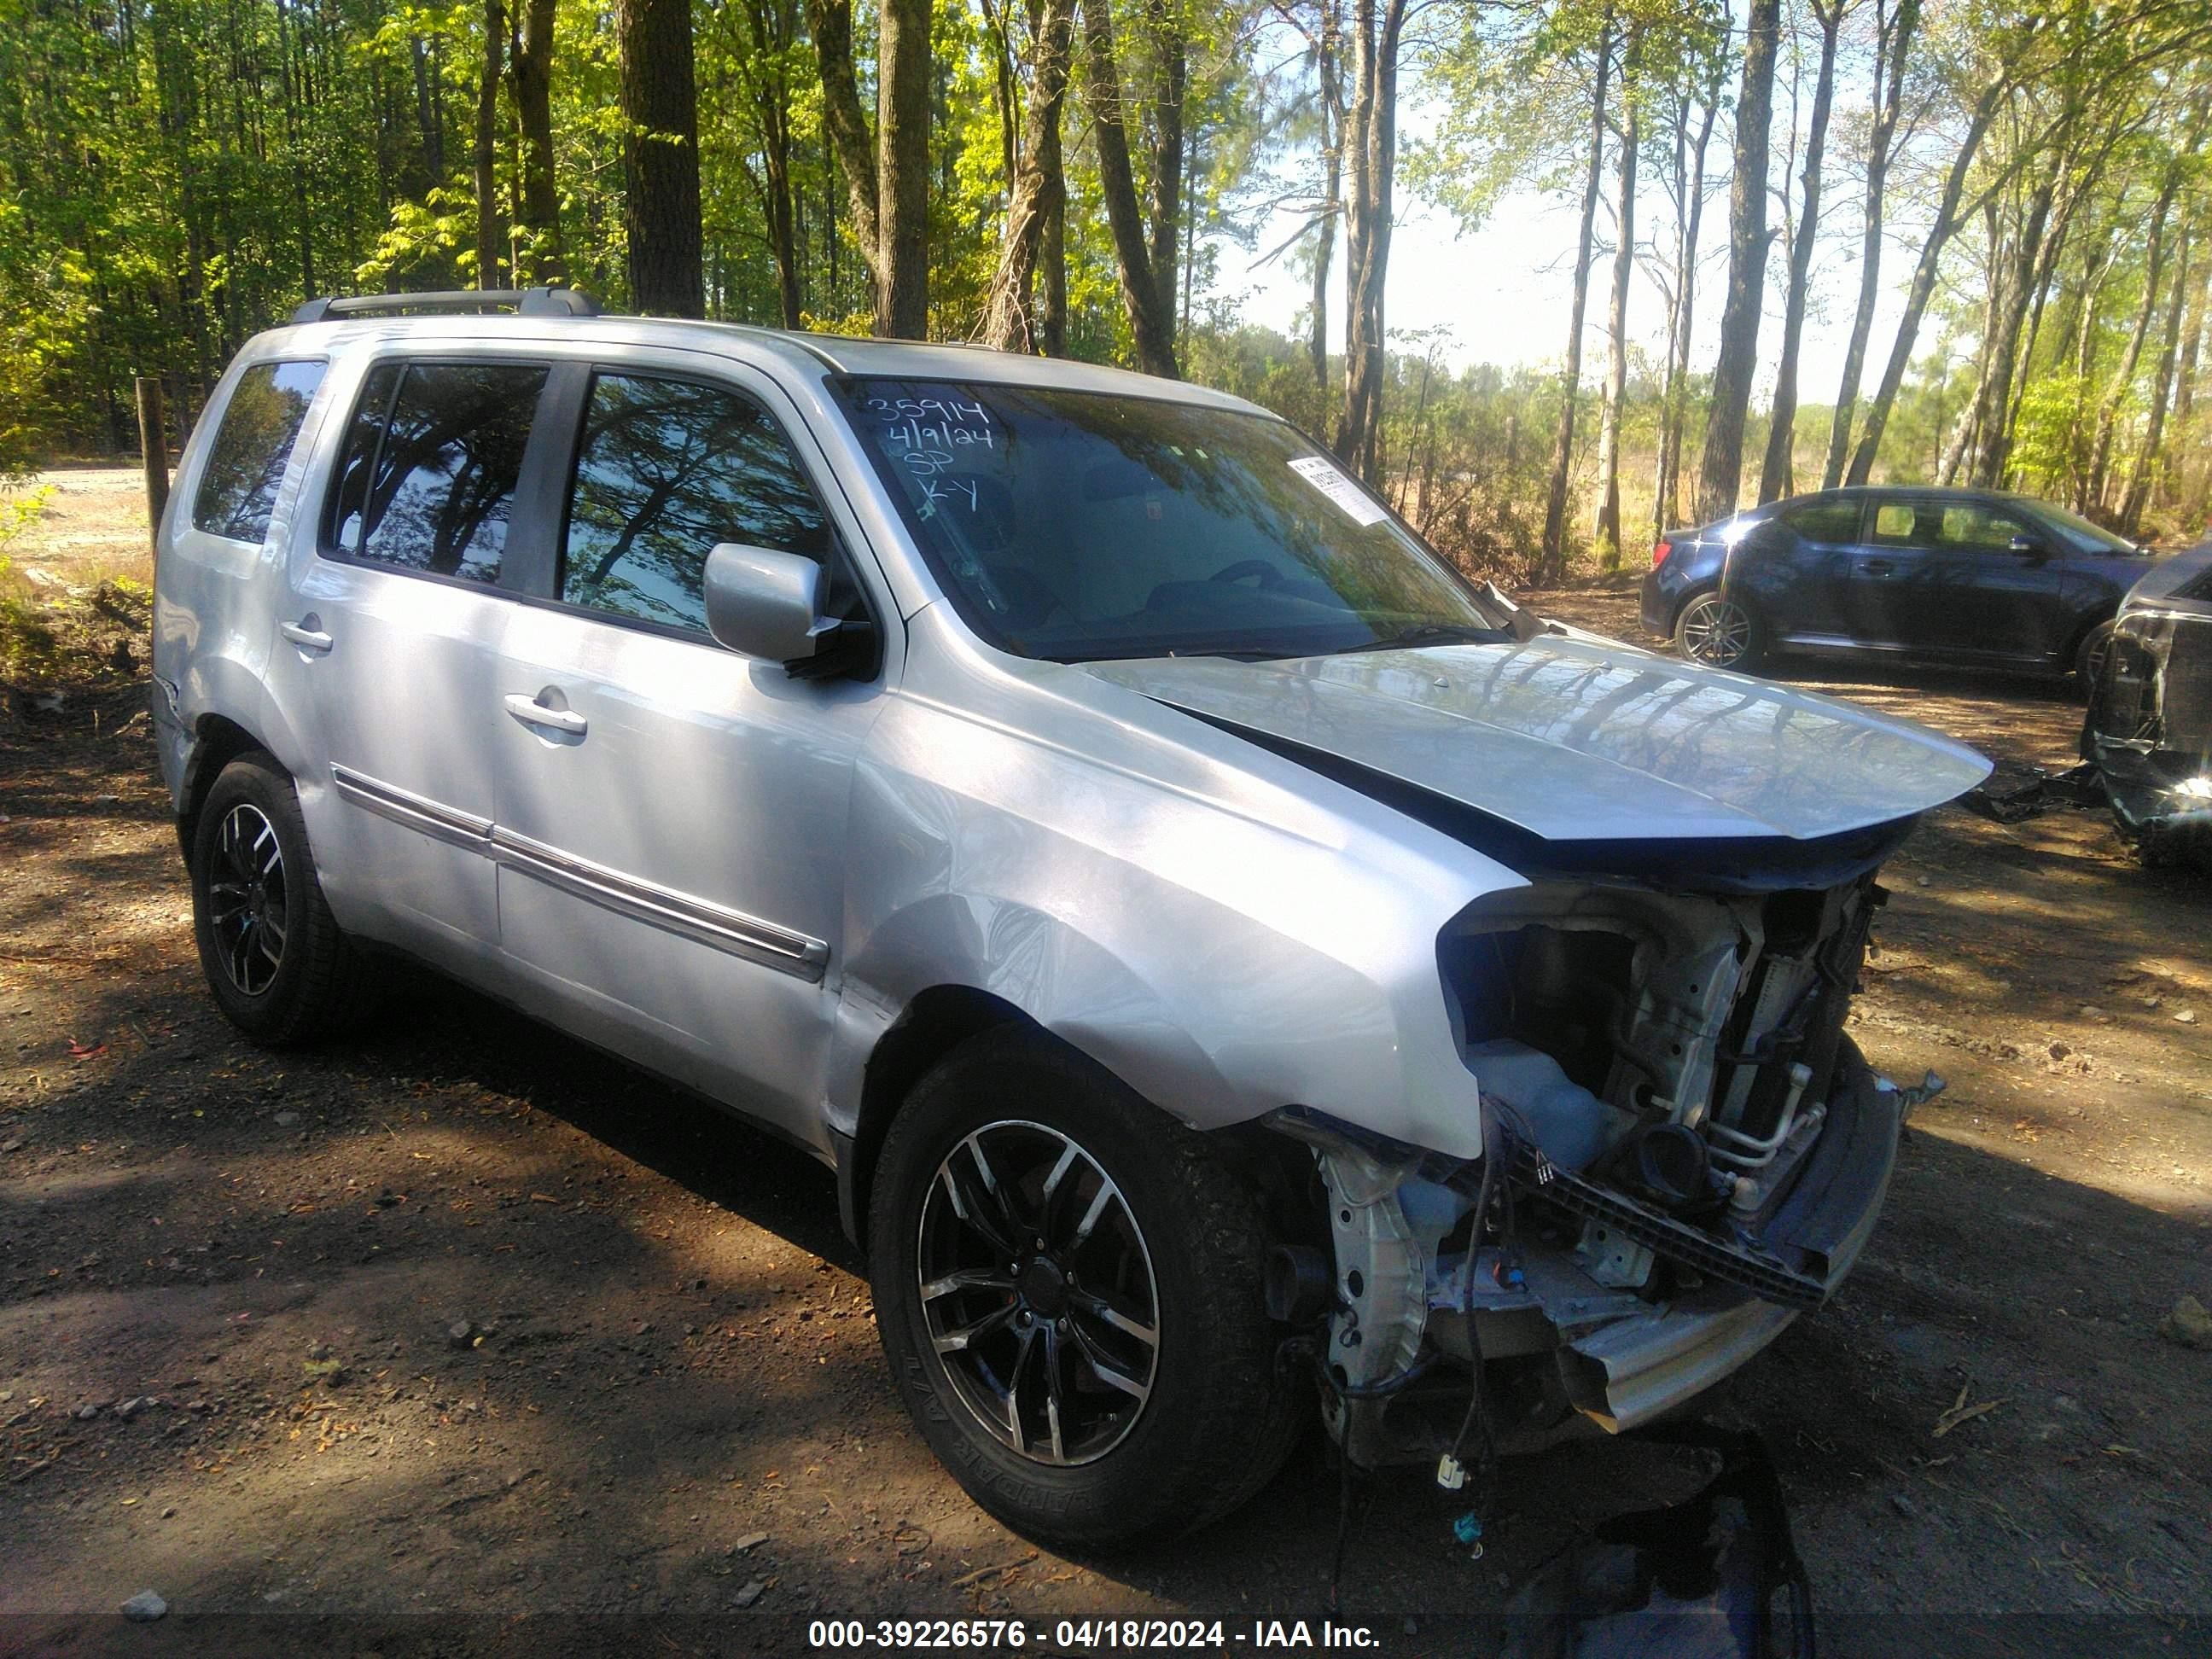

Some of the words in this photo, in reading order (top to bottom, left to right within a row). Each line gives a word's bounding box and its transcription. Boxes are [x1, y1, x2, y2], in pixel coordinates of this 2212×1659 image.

[868, 399, 990, 424] 35914
[889, 419, 993, 450] 4/9/24
[904, 450, 954, 475] SP
